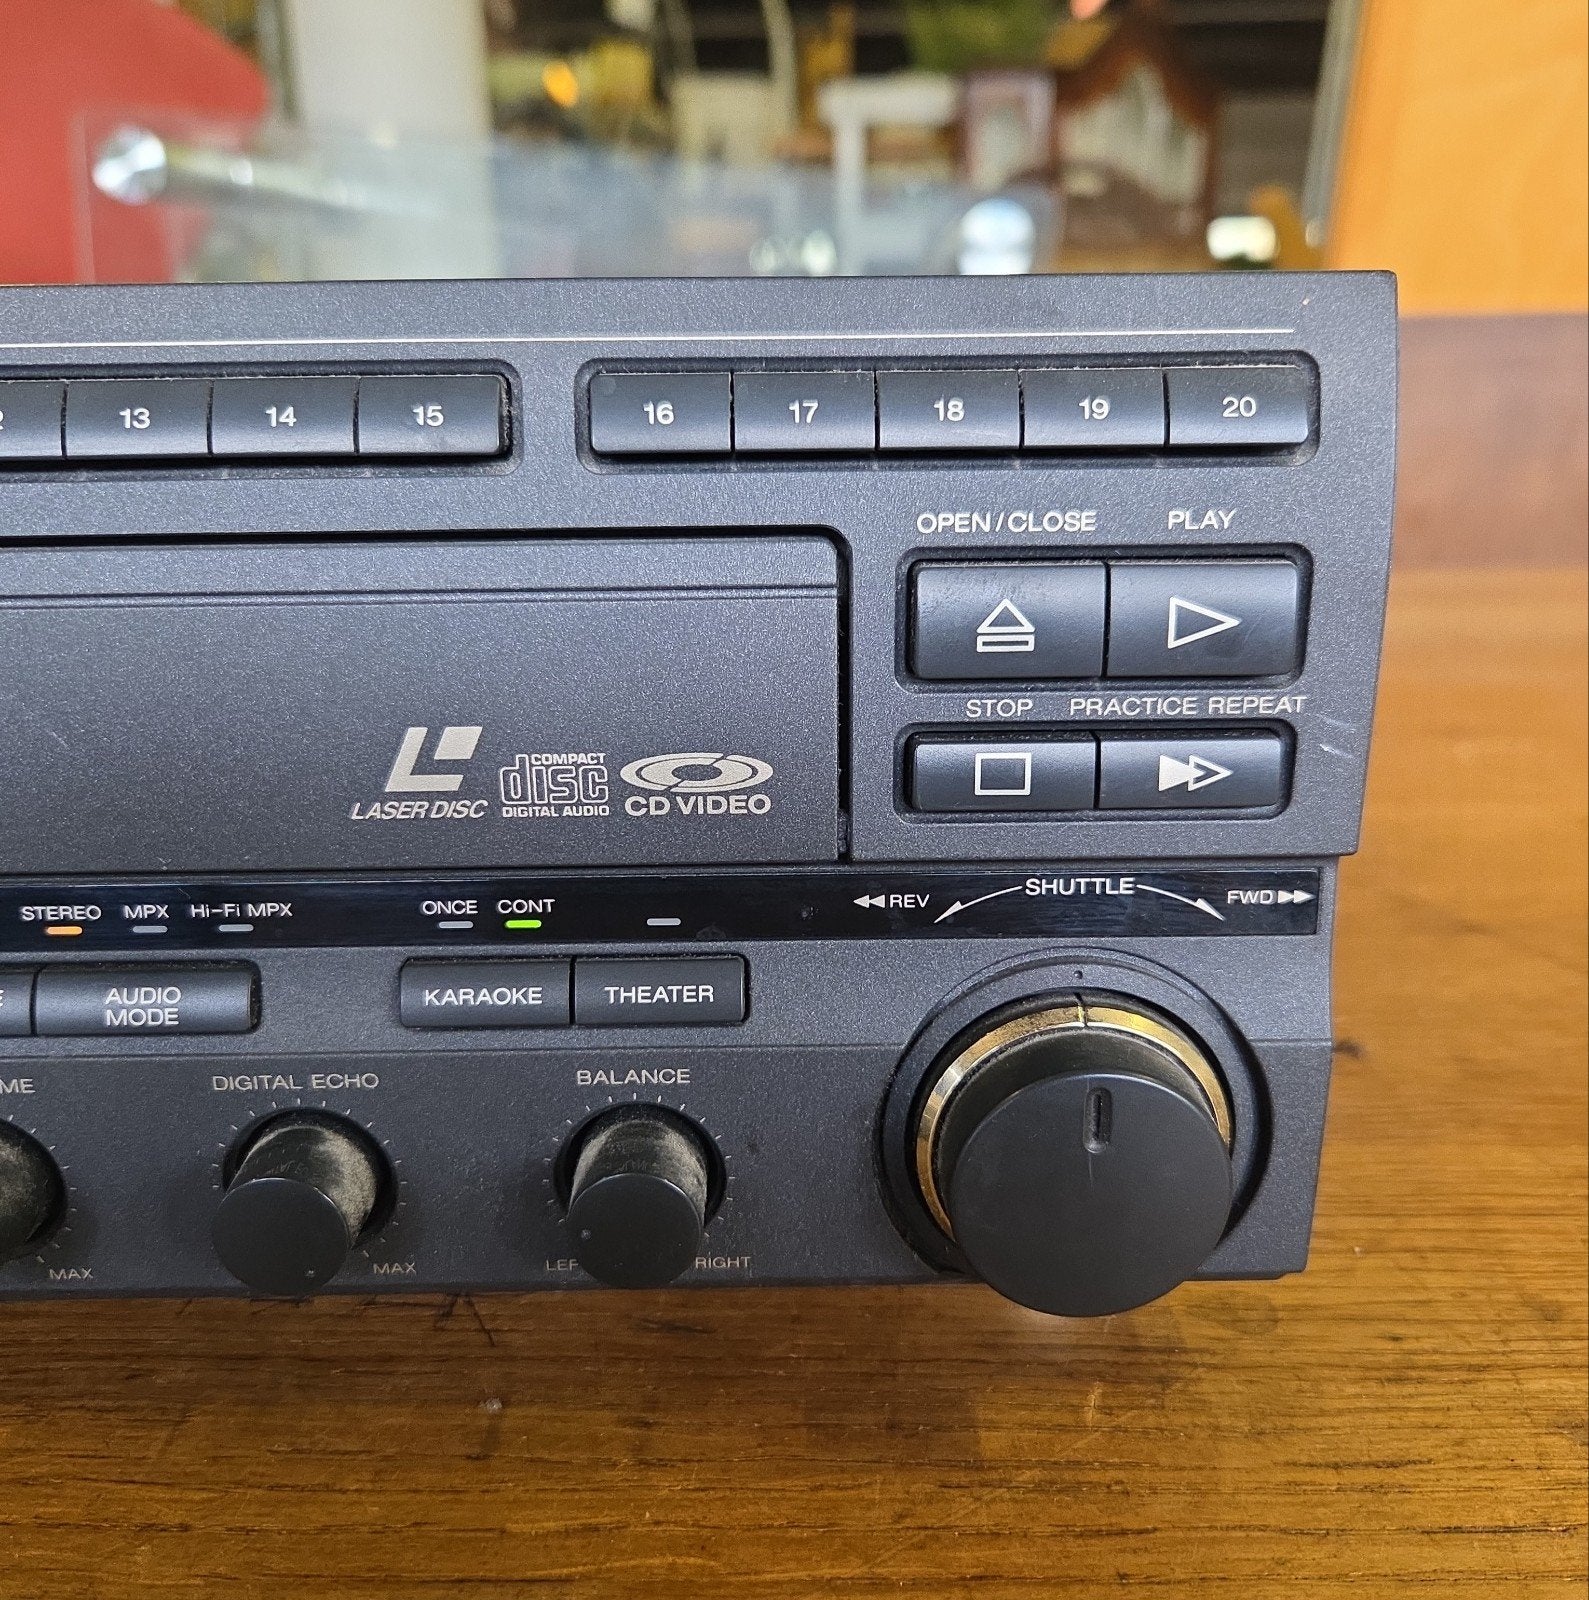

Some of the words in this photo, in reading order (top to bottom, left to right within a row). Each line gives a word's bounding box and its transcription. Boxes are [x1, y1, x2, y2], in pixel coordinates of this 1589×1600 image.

[412, 405, 444, 427] 15
[643, 401, 675, 425] 16
[788, 400, 819, 424] 17
[933, 399, 965, 422] 18
[1078, 398, 1110, 420] 19
[1222, 396, 1257, 418] 20
[119, 407, 151, 429] 13
[265, 406, 297, 428] 14
[916, 508, 1098, 534] OPEN/CLOSE
[1167, 507, 1237, 530] PLAY
[965, 698, 1034, 718] STOP
[1069, 695, 1198, 717] PRACTICE
[1208, 694, 1308, 715] REPEAT
[530, 752, 607, 766] COMPACT
[350, 802, 426, 820] LASER
[427, 800, 490, 819] DISC
[502, 805, 559, 818] DIGITAL
[562, 804, 610, 817] AUDIO
[624, 795, 671, 817] CD
[680, 794, 772, 815] VIDEO
[1024, 877, 1136, 897] SHUTTLE
[497, 898, 556, 914] CONT
[889, 893, 930, 908] REV
[1226, 889, 1274, 905] FWD
[20, 905, 102, 921] STEREO
[123, 904, 170, 919] MPX
[190, 903, 241, 918] Hi-Fi
[247, 902, 293, 917] MPX
[422, 899, 479, 915] ONCE
[103, 986, 182, 1006] AUDIO
[424, 987, 543, 1006] KARAOKE
[604, 984, 714, 1004] THEATER
[103, 1007, 179, 1026] MODE
[212, 1074, 304, 1091] DIGITAL
[311, 1072, 380, 1089] ECHO
[576, 1068, 691, 1085] BALANCE
[373, 1262, 417, 1275] MAX
[545, 1259, 579, 1271] LEF
[695, 1256, 751, 1269] RIGHT
[49, 1267, 94, 1280] MAX
